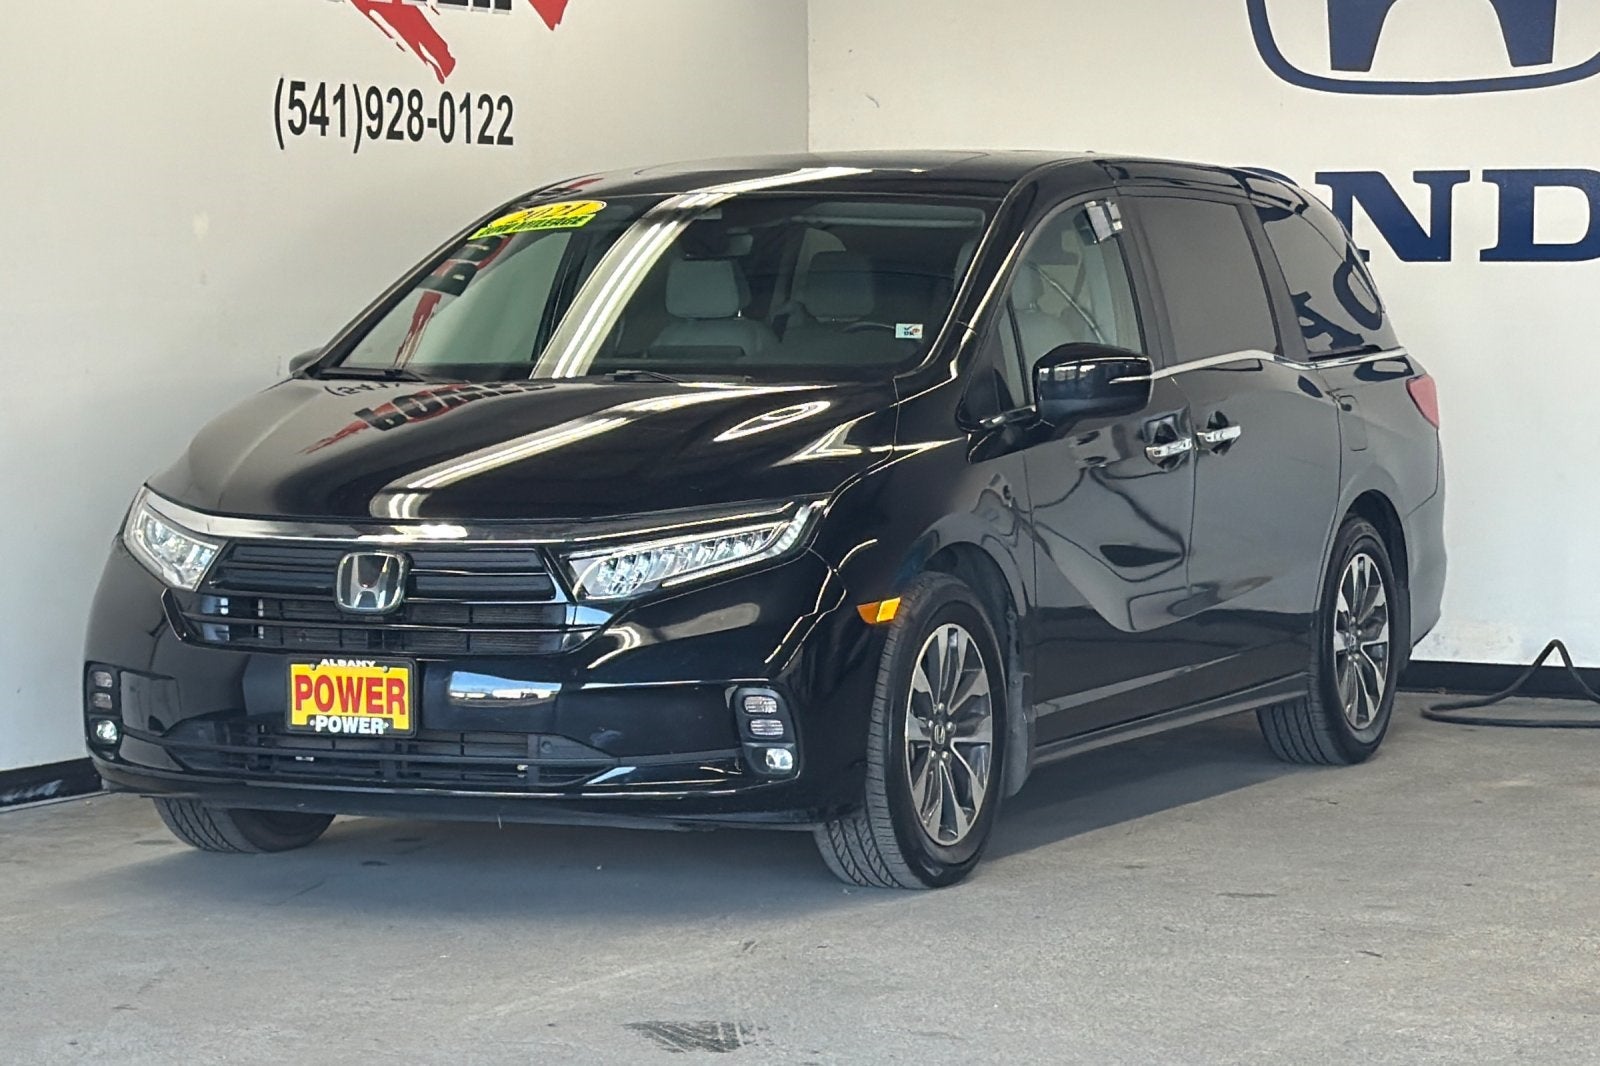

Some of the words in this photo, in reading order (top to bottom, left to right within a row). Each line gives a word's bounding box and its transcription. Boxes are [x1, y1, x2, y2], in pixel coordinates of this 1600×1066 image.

[274, 77, 514, 154] (541)928-0122
[1240, 167, 1600, 262] ND
[320, 658, 376, 667] ALBANY
[295, 674, 406, 715] POWER
[315, 715, 384, 734] POWER
